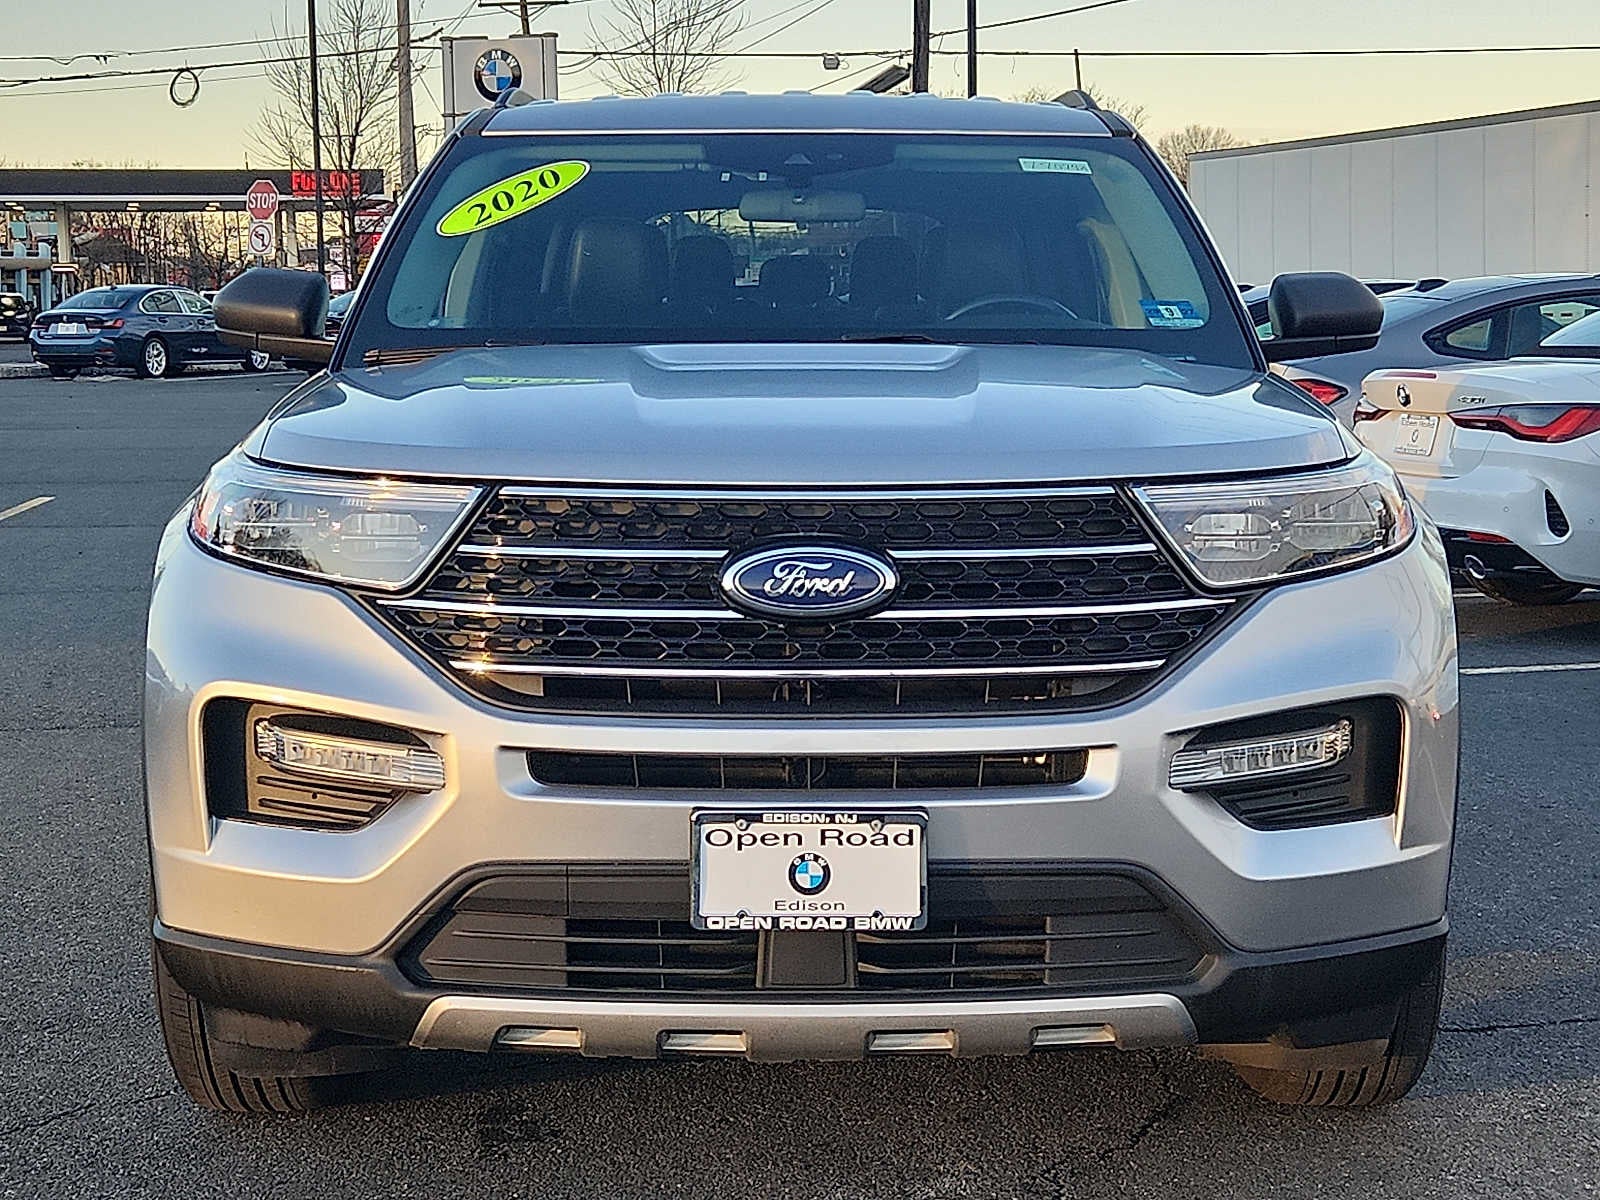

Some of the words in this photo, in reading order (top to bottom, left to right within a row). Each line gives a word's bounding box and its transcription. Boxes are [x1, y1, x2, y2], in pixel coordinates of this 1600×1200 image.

[477, 50, 518, 69] BMW
[249, 192, 277, 209] STOP
[467, 169, 561, 226] 2020
[763, 560, 856, 598] Ford
[835, 813, 858, 824] NJ
[705, 828, 803, 851] Open
[820, 828, 914, 847] Road
[774, 900, 845, 912] Edison
[706, 916, 773, 930] OPEN
[779, 916, 848, 930] ROAD
[854, 916, 913, 930] BMW
